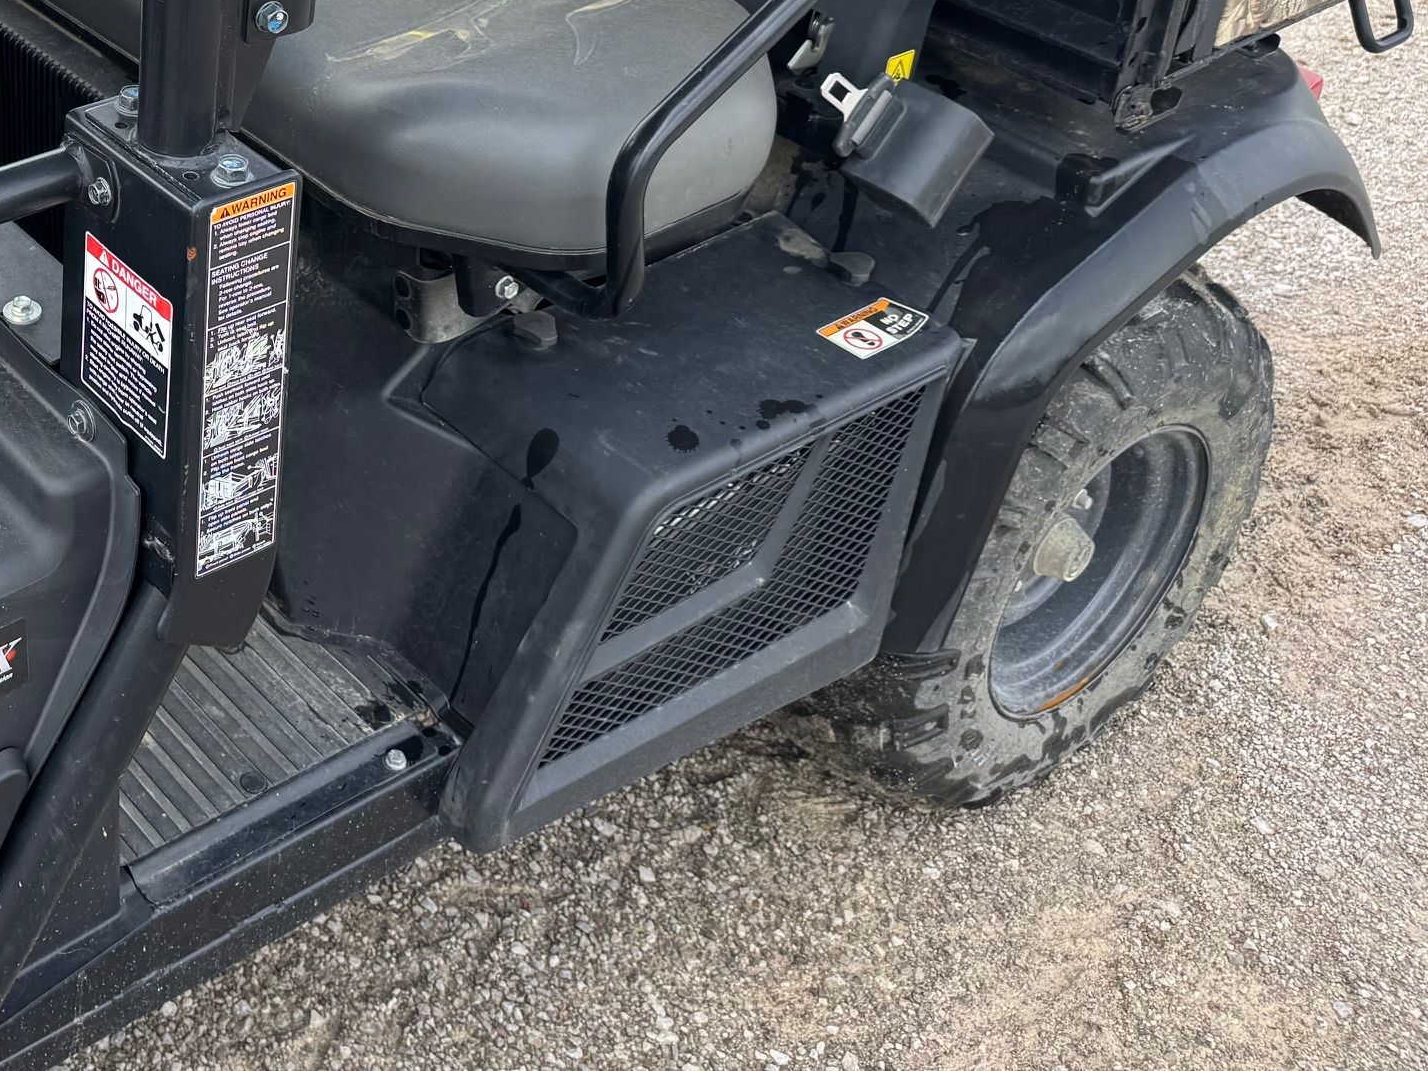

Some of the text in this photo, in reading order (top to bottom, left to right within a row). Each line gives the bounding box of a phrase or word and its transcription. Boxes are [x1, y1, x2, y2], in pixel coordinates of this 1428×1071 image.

[232, 187, 286, 214] WARNING
[213, 222, 221, 230] TO
[221, 216, 238, 227] AVOID
[239, 206, 269, 221] PERSONAL
[219, 223, 236, 234] Always
[211, 252, 267, 277] SEATING CHANGE
[211, 262, 259, 285] INSTRUCTIONS
[111, 258, 157, 308] DANGER
[880, 314, 899, 325] NO
[886, 313, 914, 334] STEP
